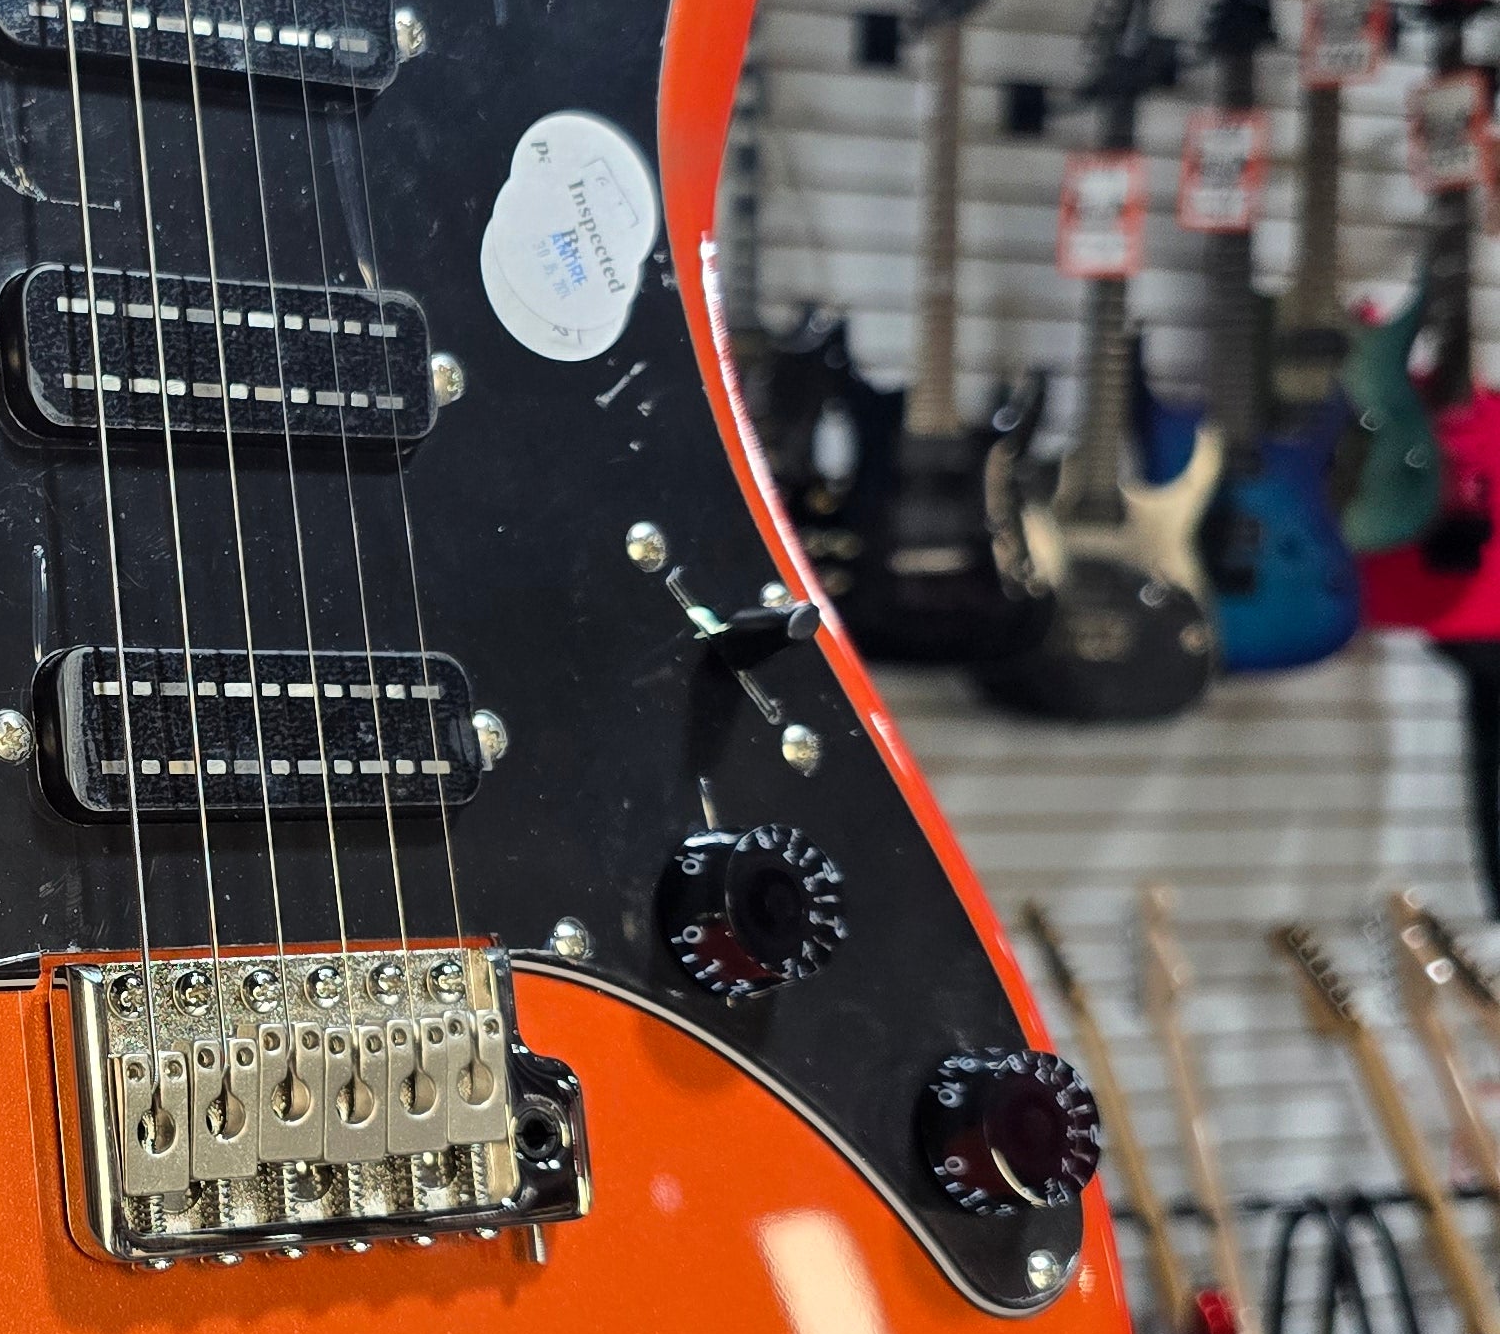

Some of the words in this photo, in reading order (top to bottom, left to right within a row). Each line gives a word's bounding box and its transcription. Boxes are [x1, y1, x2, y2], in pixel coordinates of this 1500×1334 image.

[568, 179, 626, 293] Inspected
[682, 924, 703, 944] 0
[944, 1155, 965, 1175] 0
